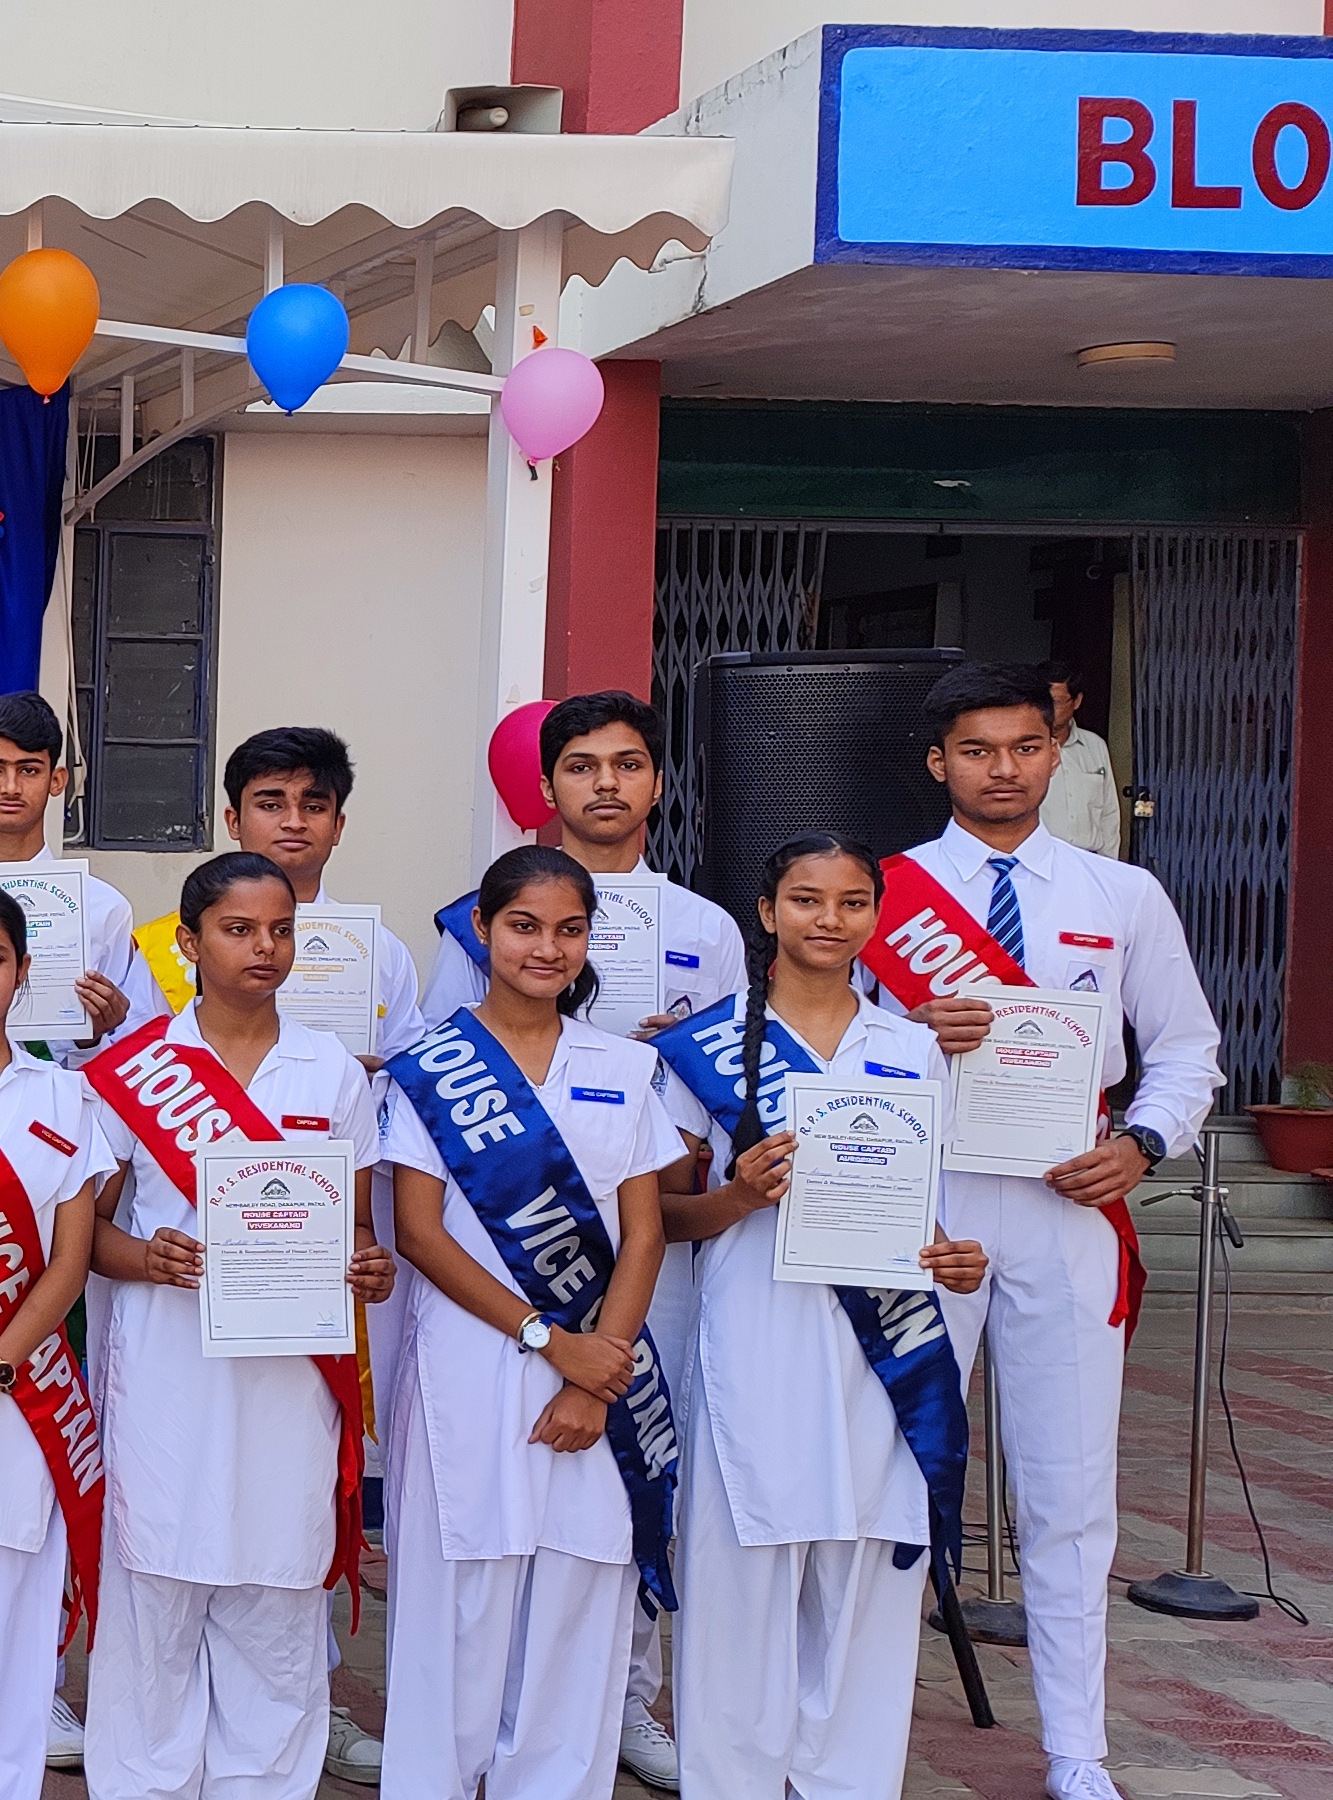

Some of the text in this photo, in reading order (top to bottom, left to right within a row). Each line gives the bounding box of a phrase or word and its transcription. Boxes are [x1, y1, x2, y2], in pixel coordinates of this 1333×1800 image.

[1075, 96, 1333, 211] BLO
[2, 880, 79, 913] SIDENTIAL SCHOOL
[625, 900, 655, 929] SCHOOL
[296, 922, 369, 959] SIDENTIAL SCHOOL
[885, 907, 1002, 997] HOU
[995, 1005, 1093, 1048] RESIDENTIAL SCHOOL
[827, 1096, 895, 1113] RESIDENTIAL
[897, 1108, 929, 1144] SCHOOL
[237, 1161, 306, 1179] RESIDENTIAL
[309, 1171, 342, 1205] SCHOOL
[407, 1022, 526, 1154] HOUSE
[505, 1185, 597, 1305] VICE
[28, 1332, 105, 1497] APTAIN
